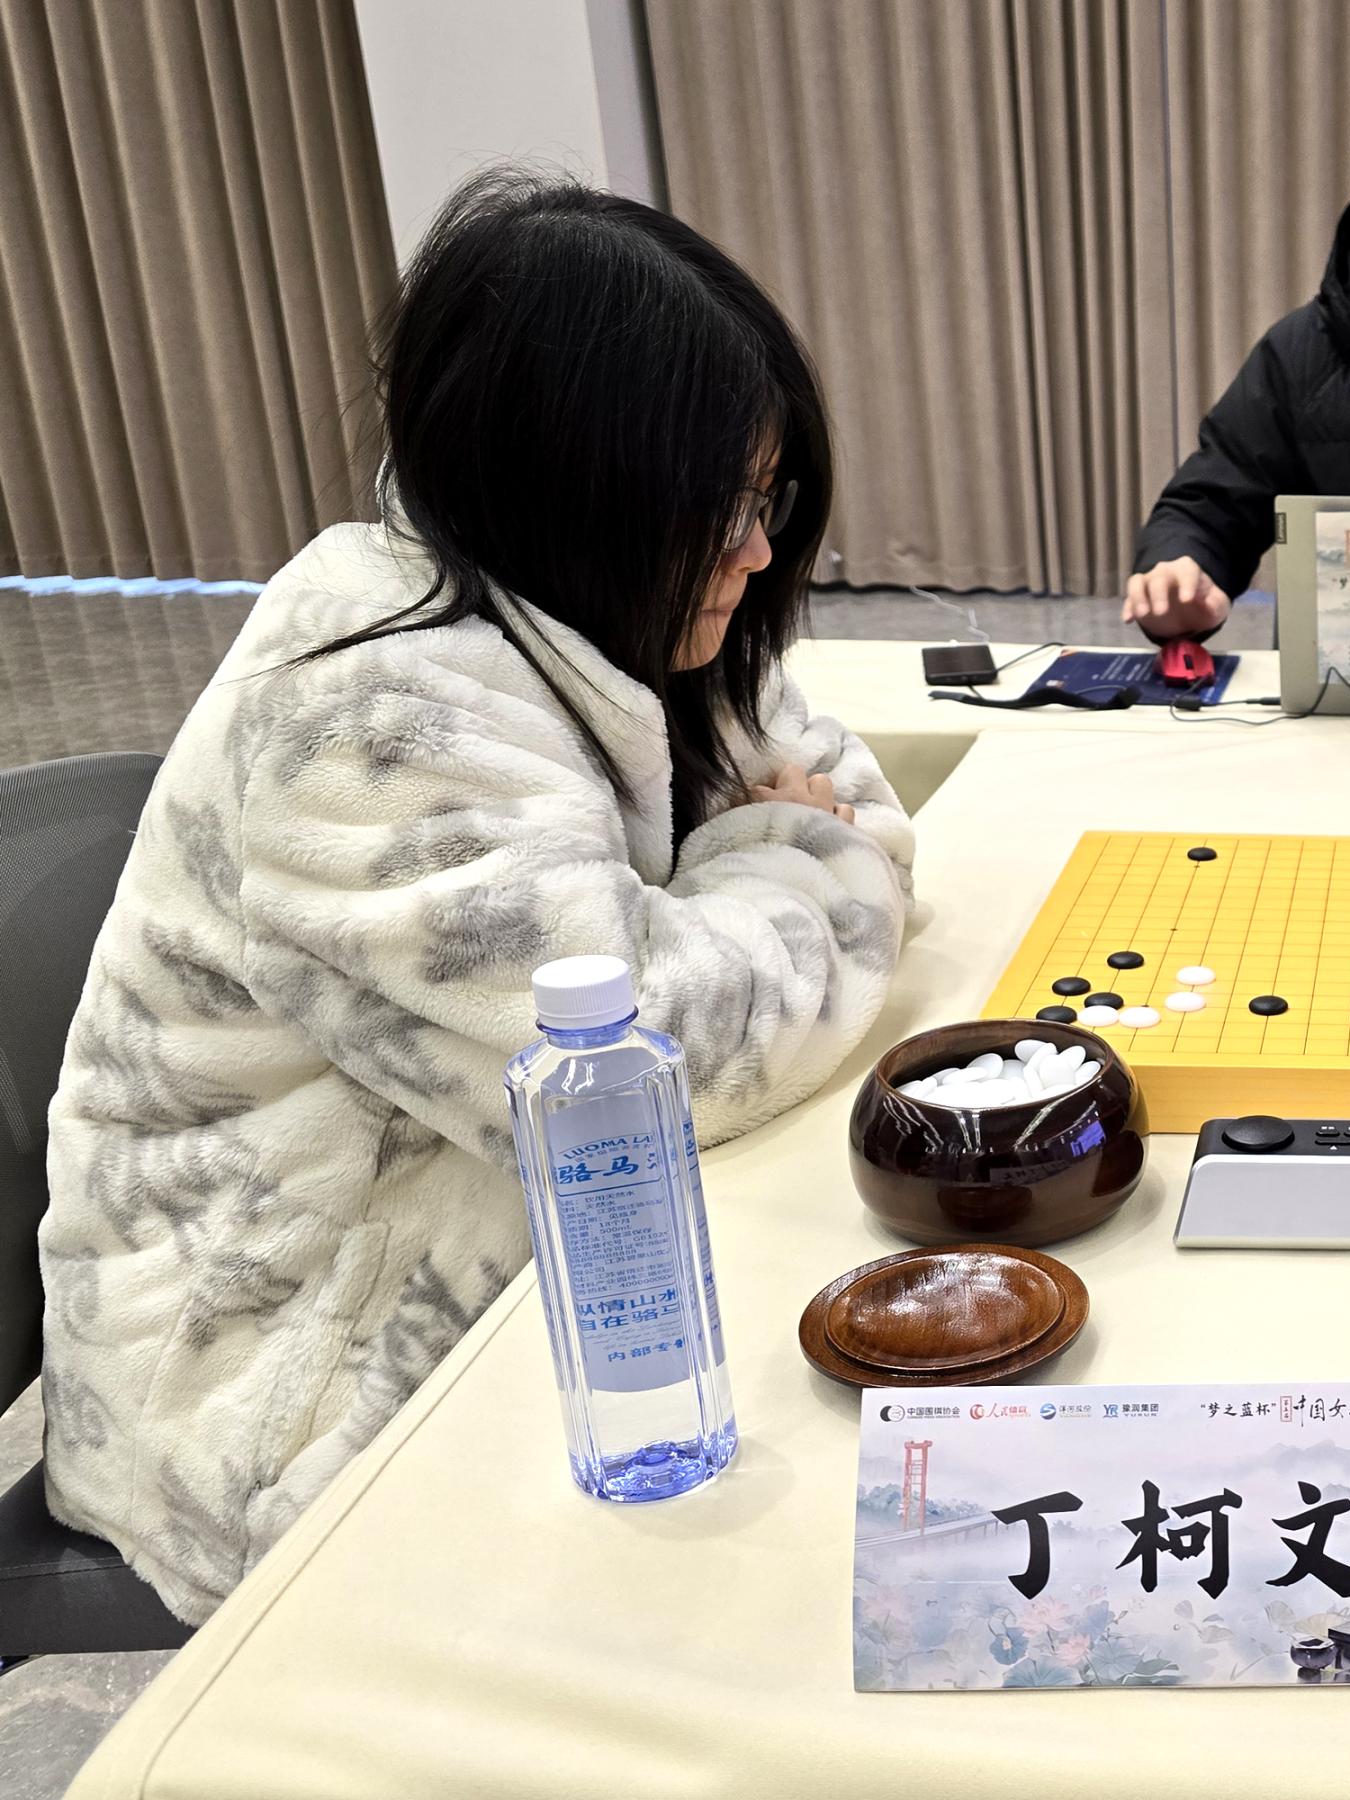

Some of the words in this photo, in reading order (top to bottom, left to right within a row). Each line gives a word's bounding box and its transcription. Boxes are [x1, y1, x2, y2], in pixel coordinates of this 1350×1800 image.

[563, 1138, 628, 1160] LUOMA
[633, 1135, 653, 1145] LA
[906, 1405, 960, 1416] 中国围棋协会
